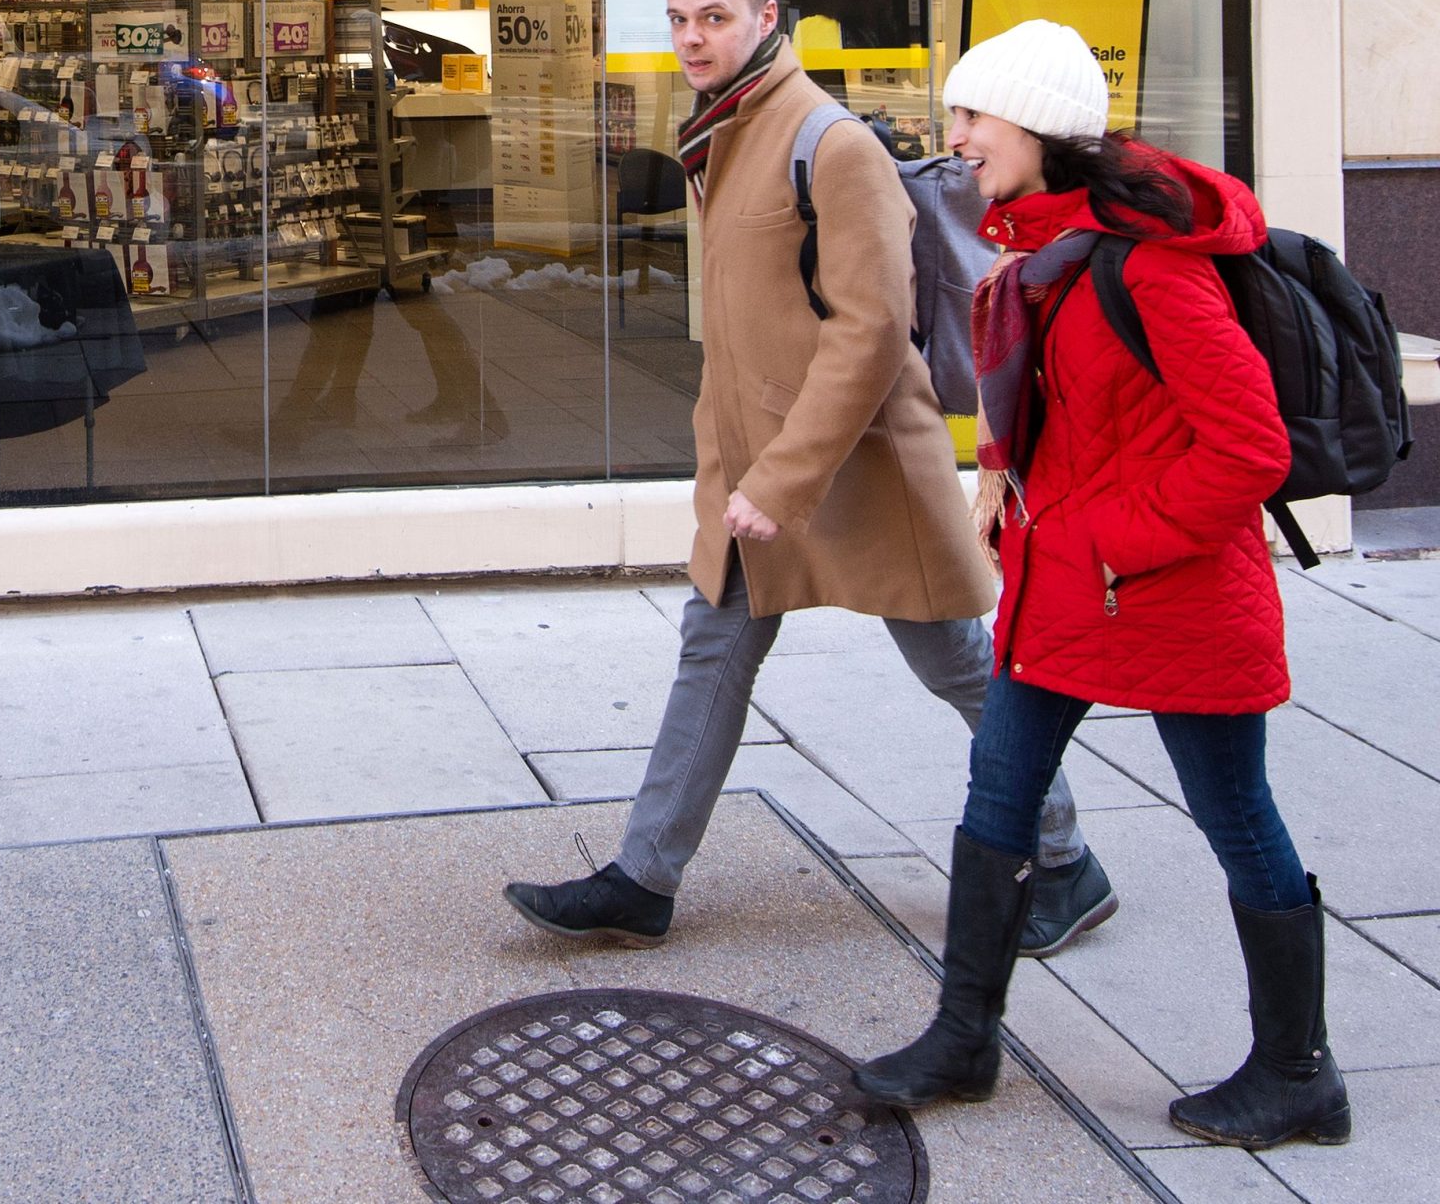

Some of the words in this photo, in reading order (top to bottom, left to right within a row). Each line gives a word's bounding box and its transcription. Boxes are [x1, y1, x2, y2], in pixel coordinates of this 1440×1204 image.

[497, 4, 525, 14] Ahorra
[118, 27, 161, 48] 30%
[498, 16, 548, 45] 50%
[565, 14, 587, 45] 50%
[148, 39, 161, 47] OFF
[1091, 46, 1126, 61] Sale
